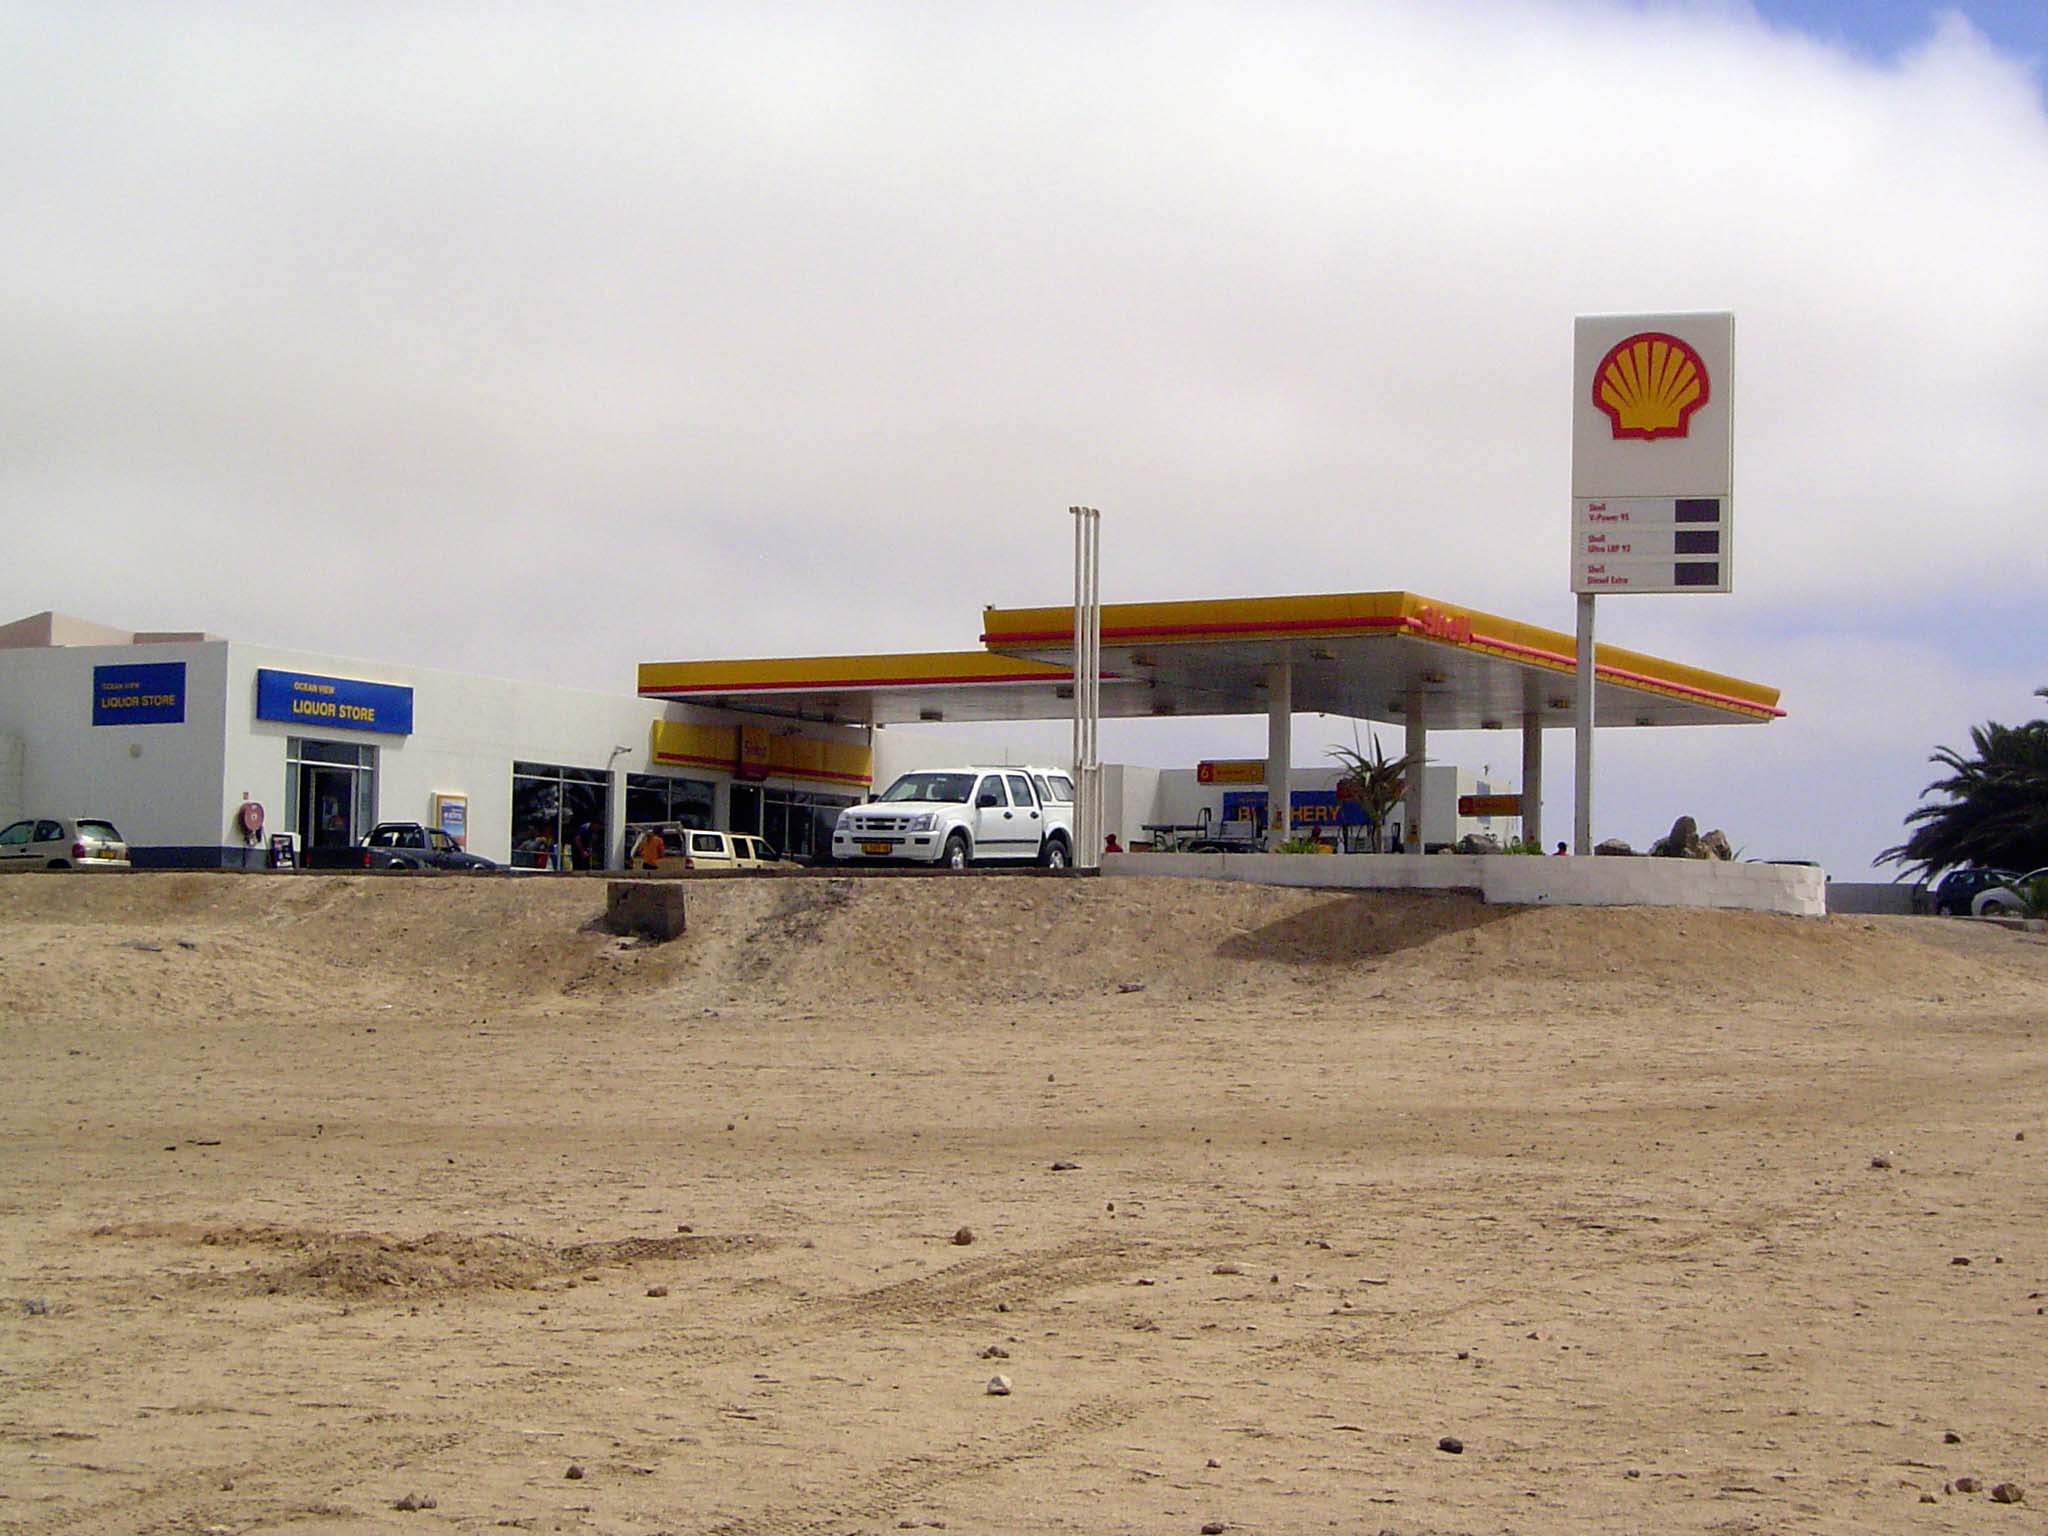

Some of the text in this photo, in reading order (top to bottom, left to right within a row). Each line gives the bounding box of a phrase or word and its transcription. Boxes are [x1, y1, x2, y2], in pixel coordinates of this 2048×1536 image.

[1422, 606, 1471, 643] Shell
[293, 681, 335, 694] OCEAN VIEW
[101, 694, 176, 708] LIQUOR STORE
[292, 699, 375, 721] LIQUOR STORE
